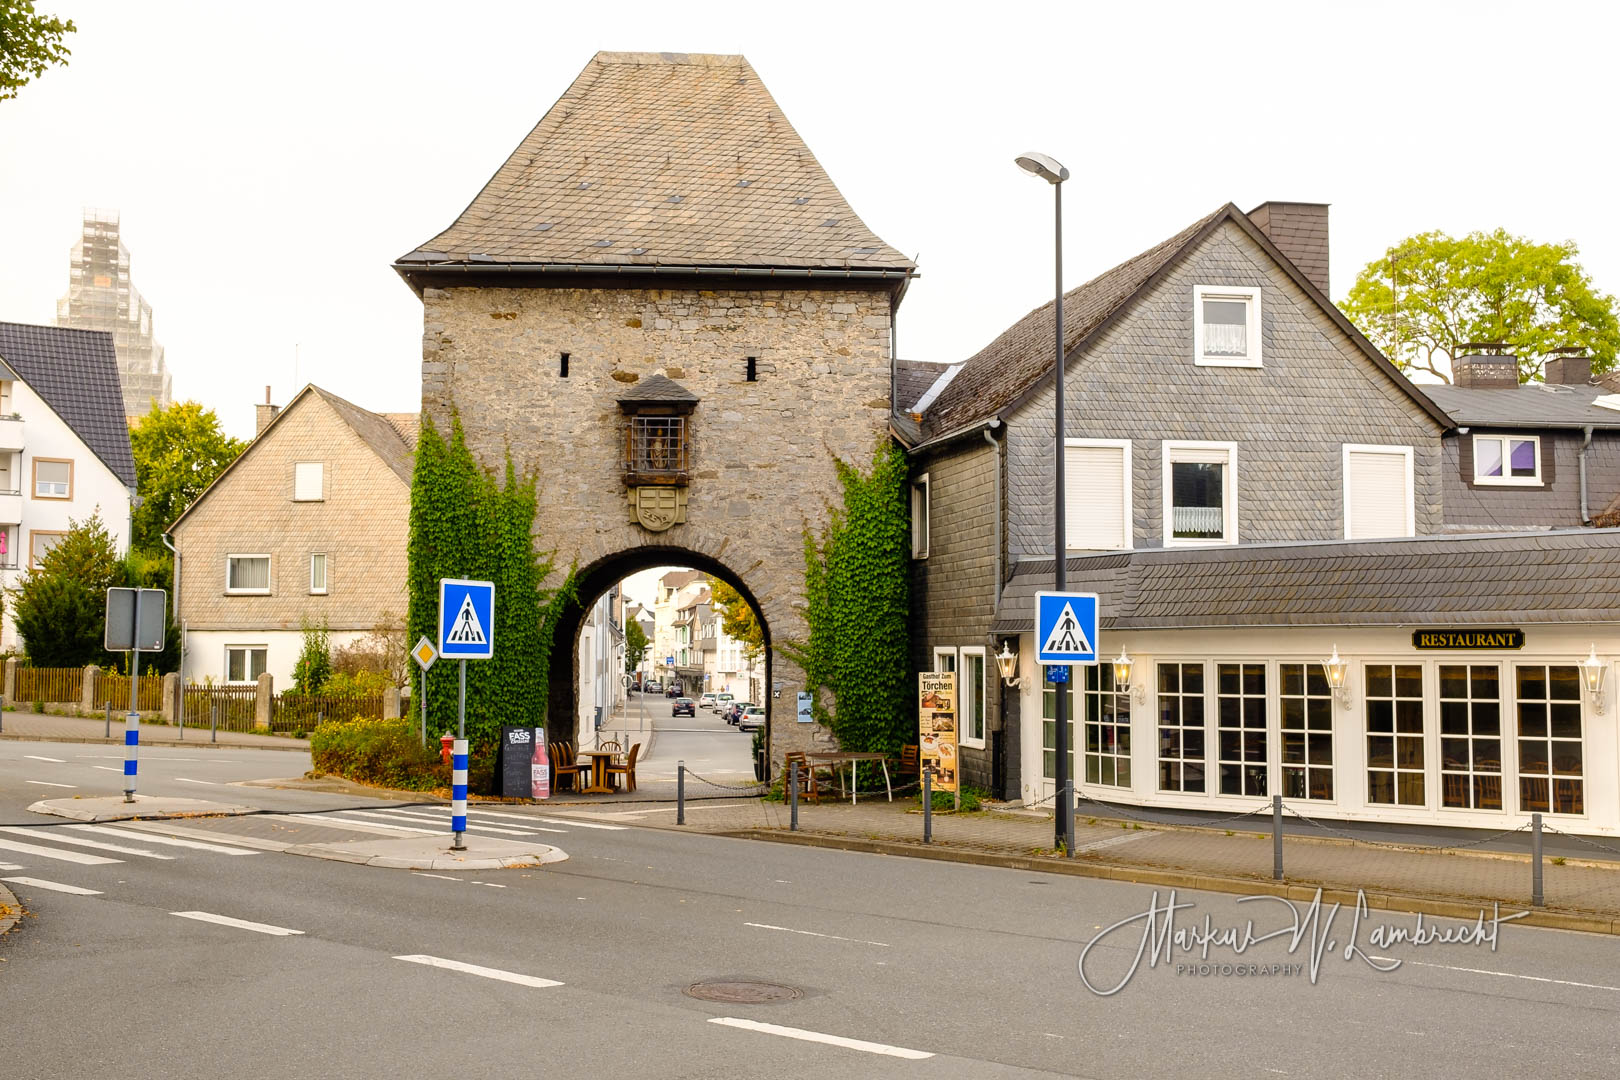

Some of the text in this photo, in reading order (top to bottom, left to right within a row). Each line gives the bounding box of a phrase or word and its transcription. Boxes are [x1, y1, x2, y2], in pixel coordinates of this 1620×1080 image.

[1421, 633, 1516, 647] RESTAURANT
[922, 681, 953, 690] Törchen
[509, 731, 531, 740] FASS
[533, 768, 547, 776] FASS
